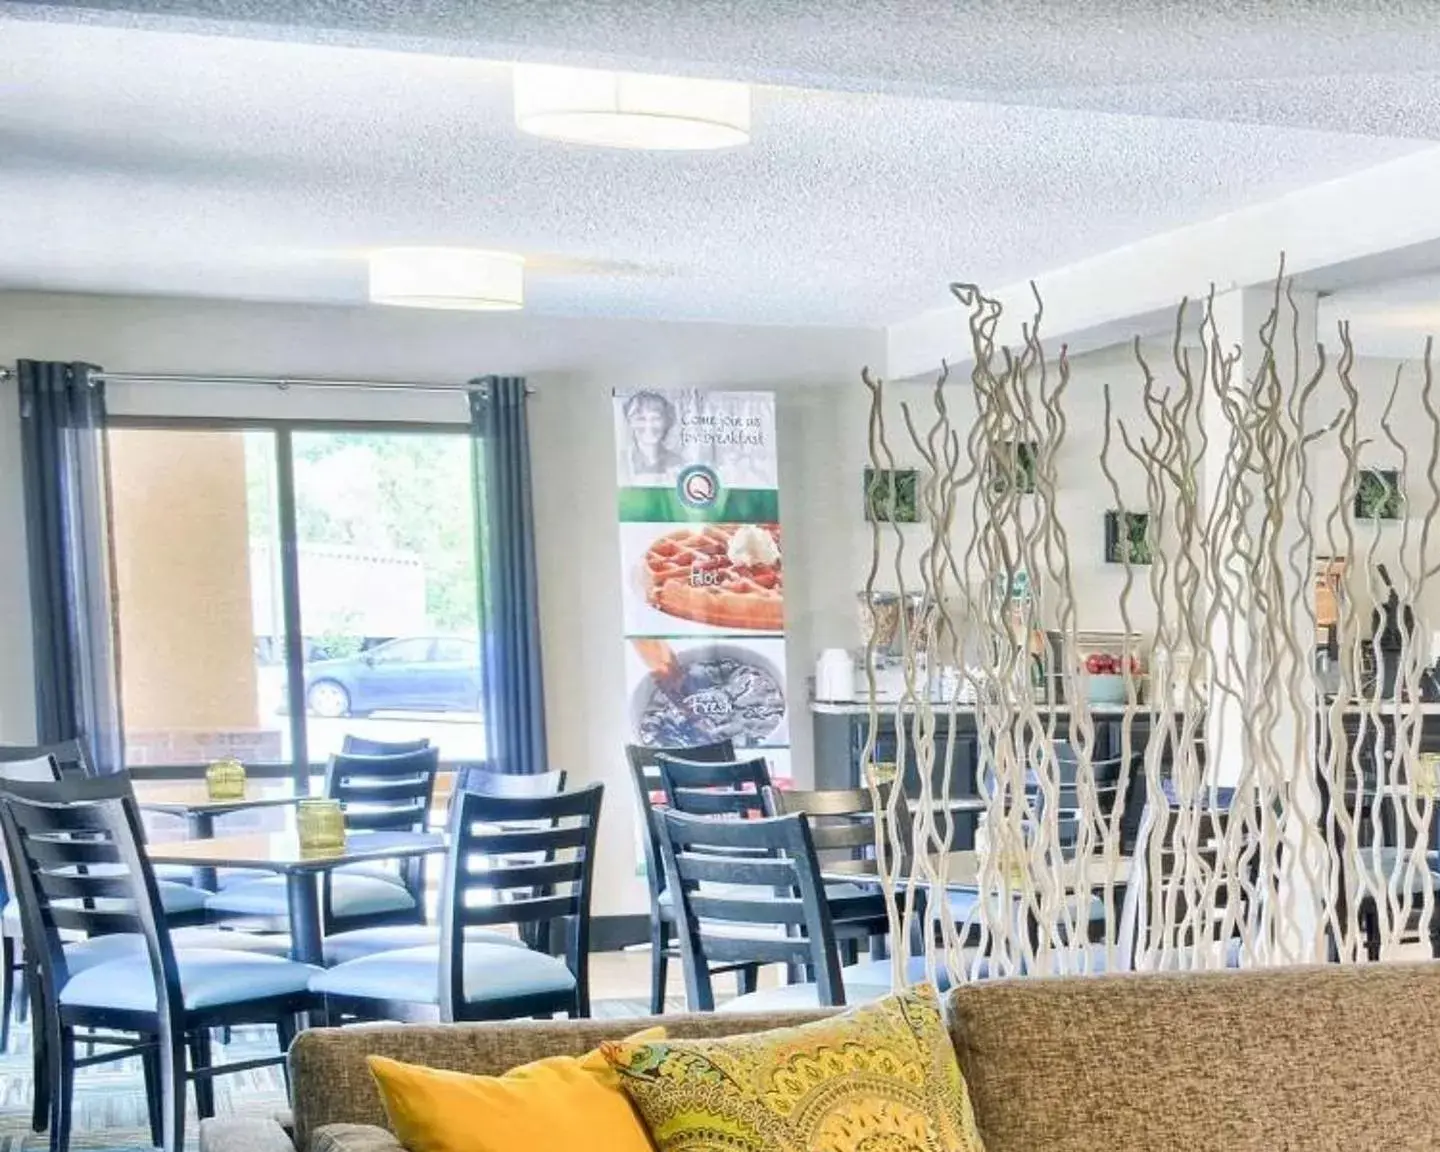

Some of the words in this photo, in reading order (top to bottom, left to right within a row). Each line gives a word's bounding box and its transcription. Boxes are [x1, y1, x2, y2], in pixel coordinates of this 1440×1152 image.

[746, 416, 761, 428] us
[690, 567, 721, 587] Hot
[688, 696, 733, 714] Fresh
